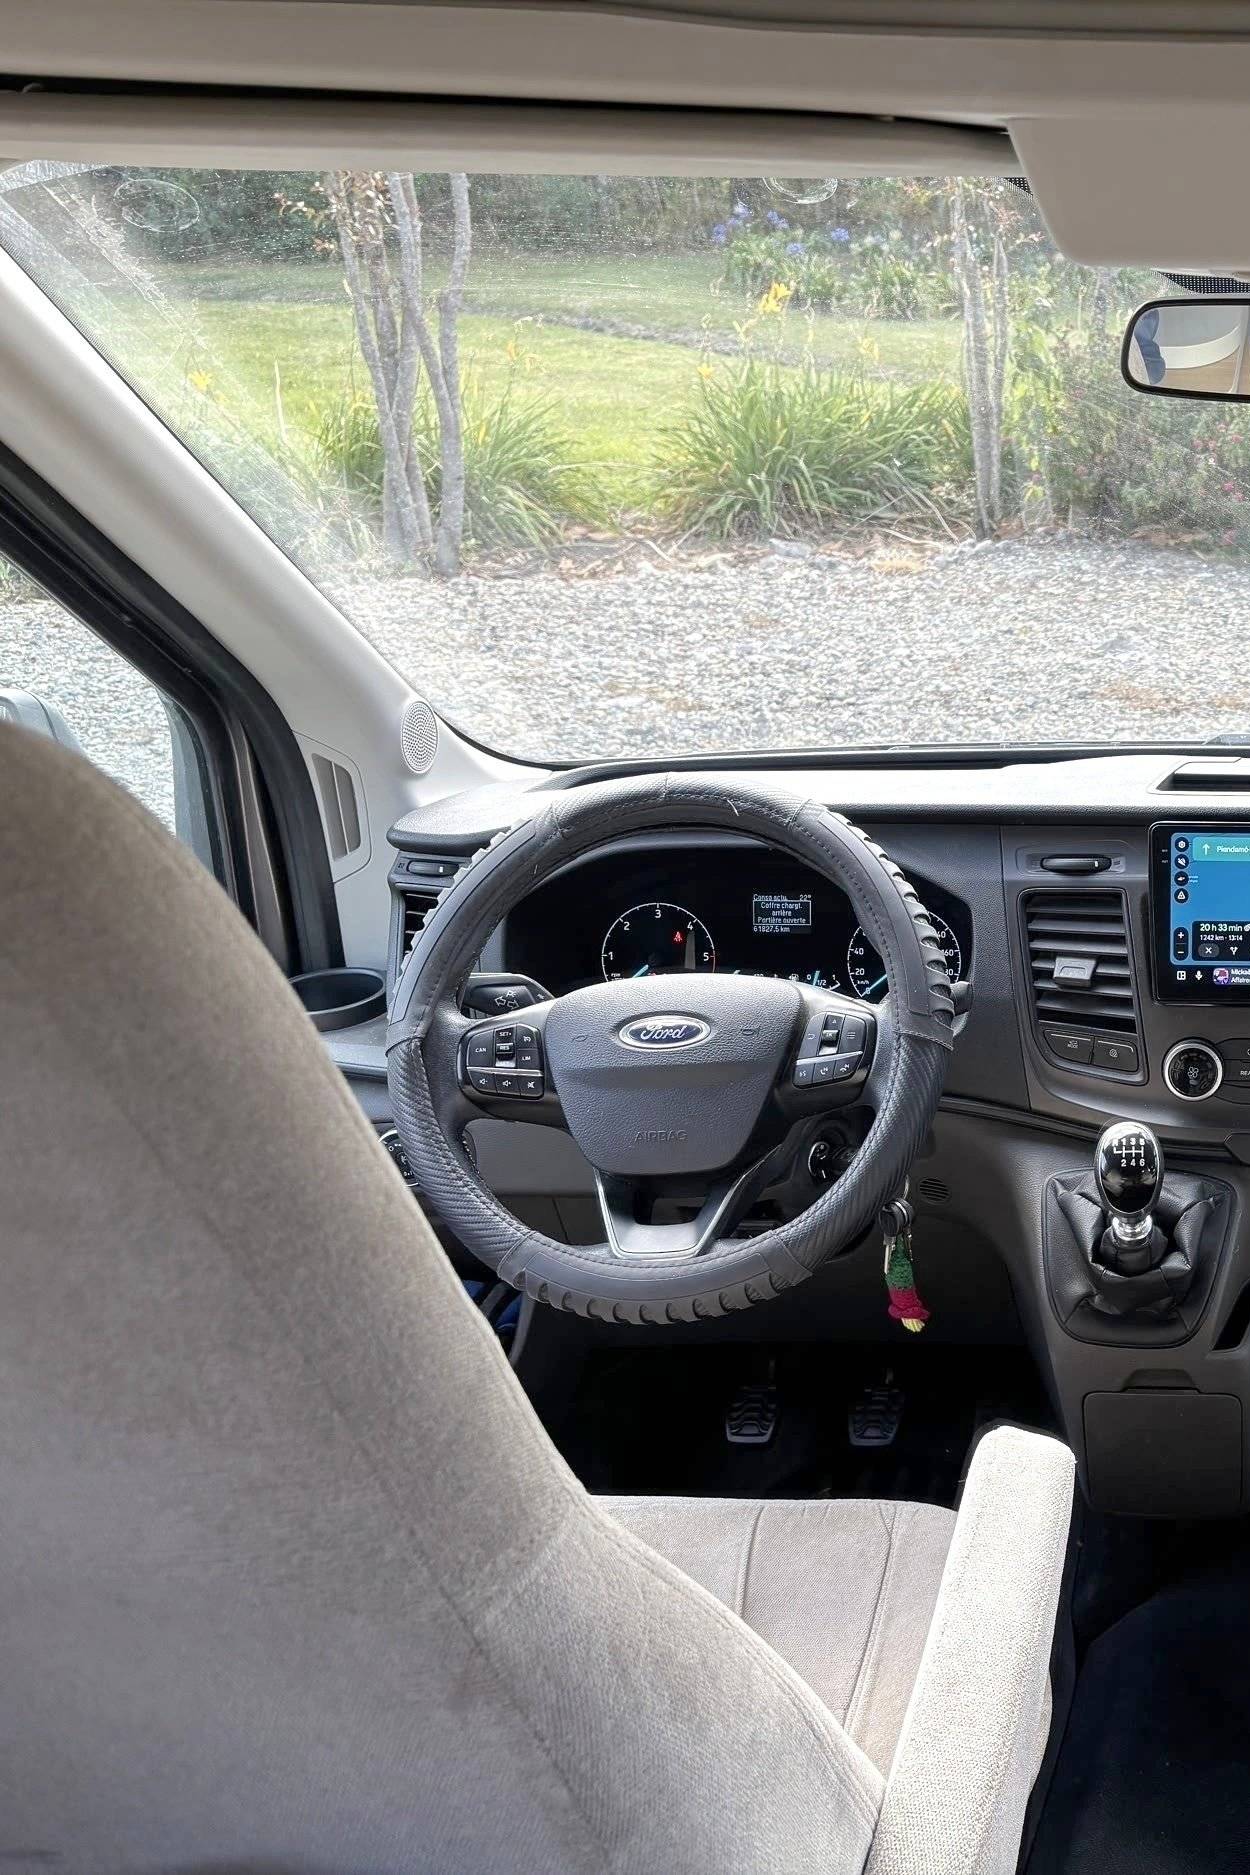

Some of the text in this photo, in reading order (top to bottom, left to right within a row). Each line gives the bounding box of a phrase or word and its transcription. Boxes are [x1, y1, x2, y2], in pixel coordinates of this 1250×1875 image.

[760, 901, 781, 909] Coffre
[654, 909, 662, 919] 3
[757, 916, 782, 924] Portière
[623, 921, 630, 931] 2
[687, 921, 694, 931] 4
[780, 925, 791, 933] km
[1200, 923, 1243, 931] 20 h 33 min
[608, 951, 613, 960] 1
[853, 947, 865, 956] 40
[703, 952, 709, 962] 5
[855, 968, 865, 976] 20
[640, 1024, 688, 1041] Ford
[1121, 1137, 1126, 1146] 1
[1130, 1137, 1136, 1147] 3
[1121, 1158, 1145, 1167] 2 4 6
